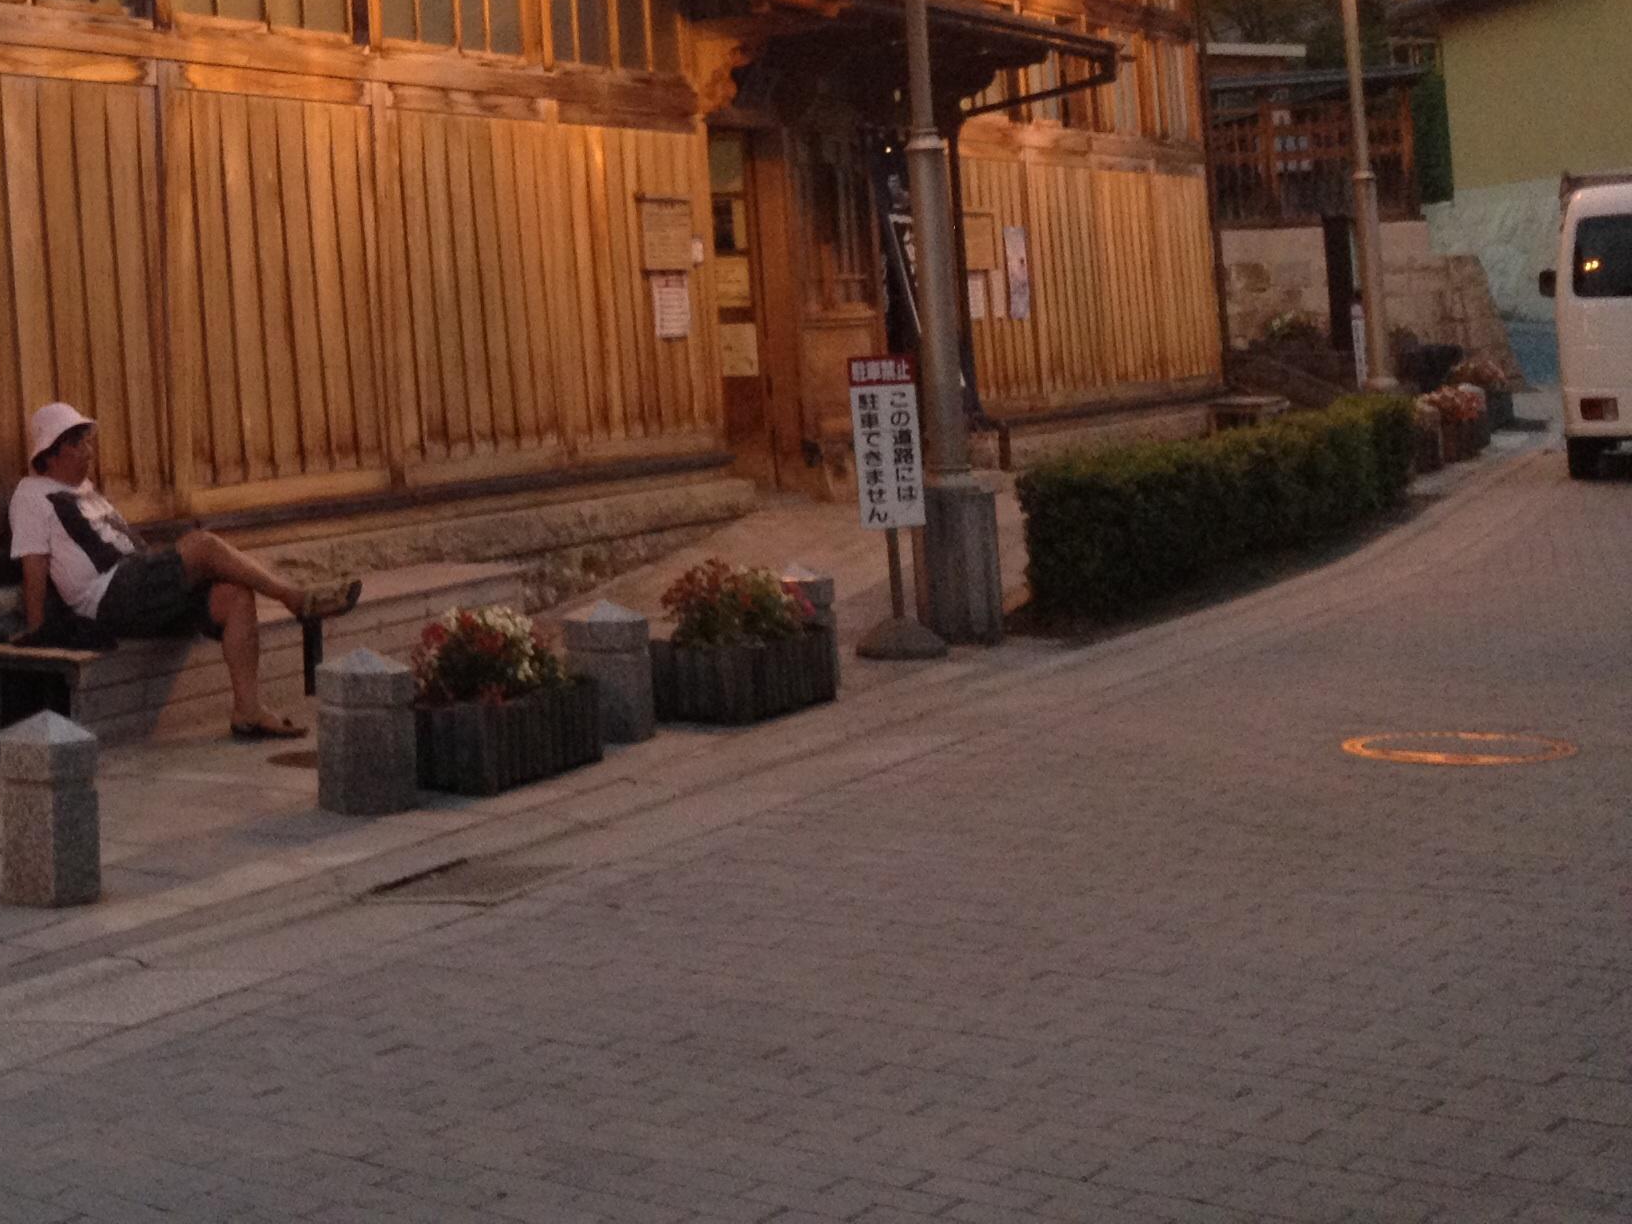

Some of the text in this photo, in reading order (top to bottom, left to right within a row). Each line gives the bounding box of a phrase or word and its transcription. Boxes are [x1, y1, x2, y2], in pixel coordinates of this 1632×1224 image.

[858, 392, 888, 524] 駐車できません
[889, 391, 917, 503] この道路には
